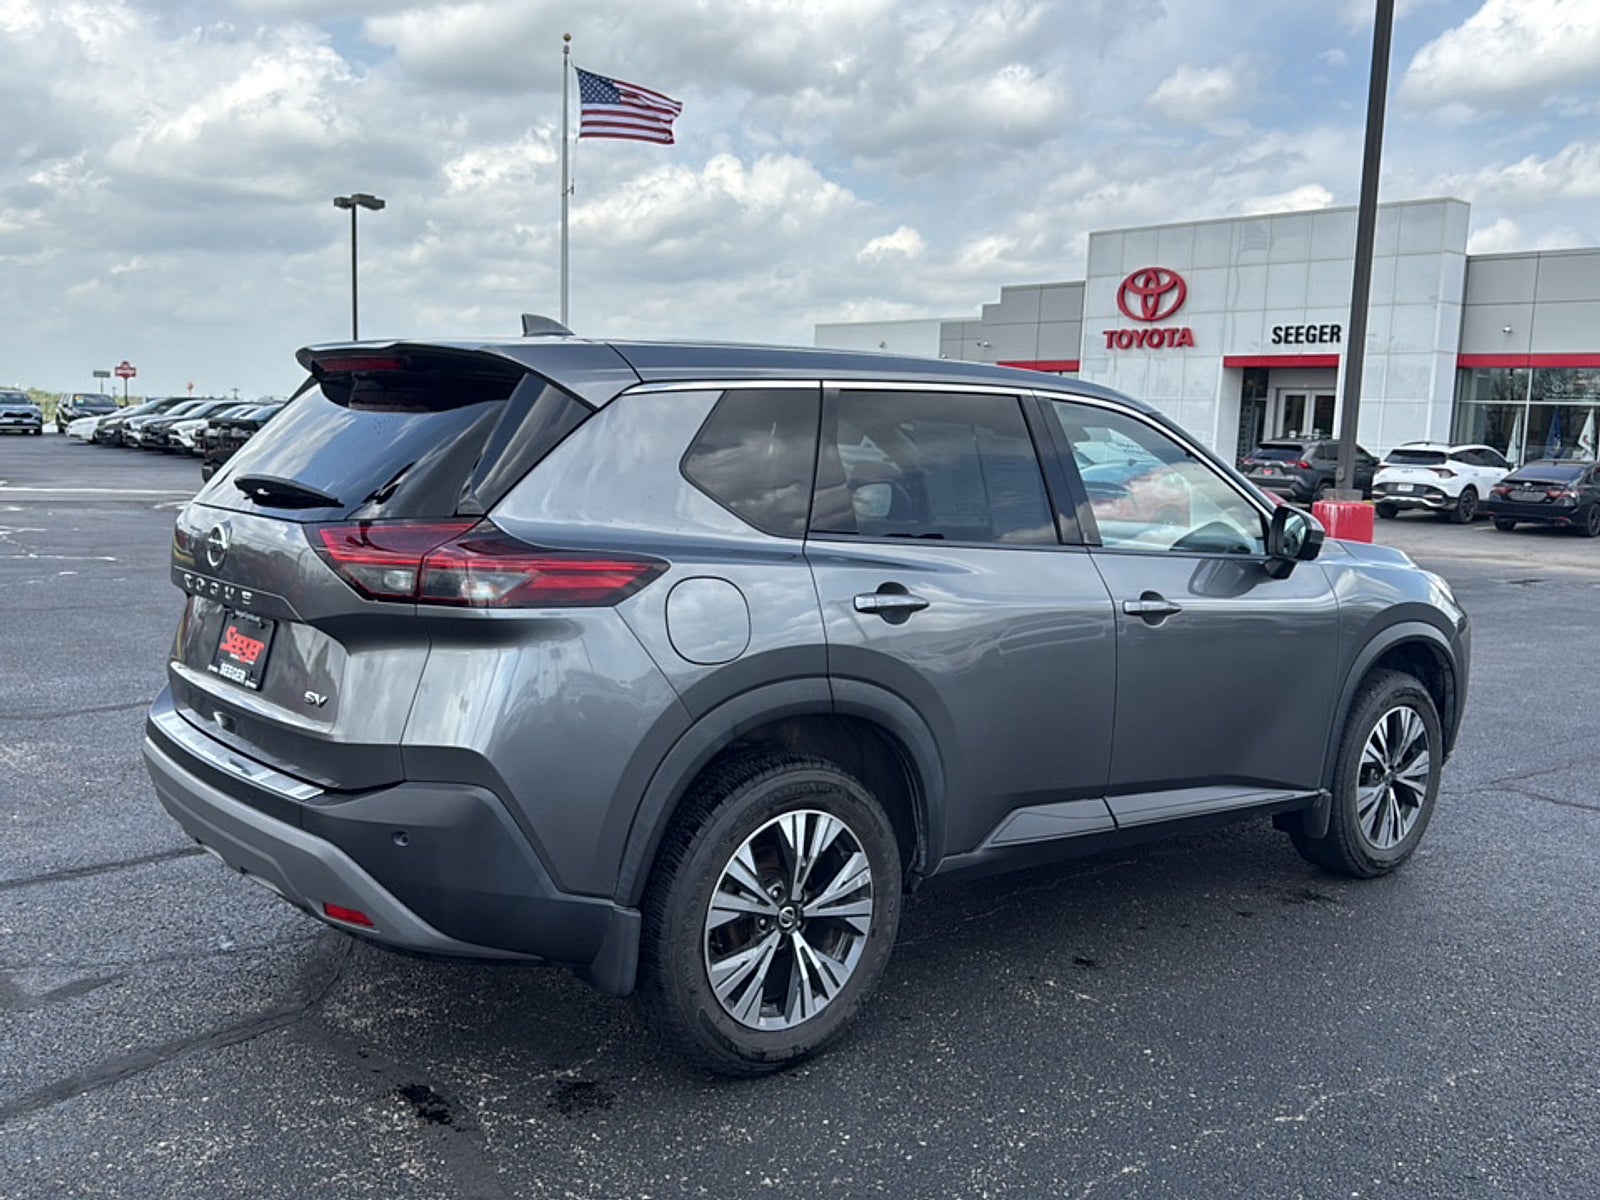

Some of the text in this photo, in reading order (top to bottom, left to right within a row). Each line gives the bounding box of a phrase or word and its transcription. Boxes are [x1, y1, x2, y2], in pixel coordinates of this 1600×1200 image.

[1103, 328, 1195, 349] TOYOTA
[1271, 324, 1342, 345] SEEGER
[304, 691, 329, 707] SV
